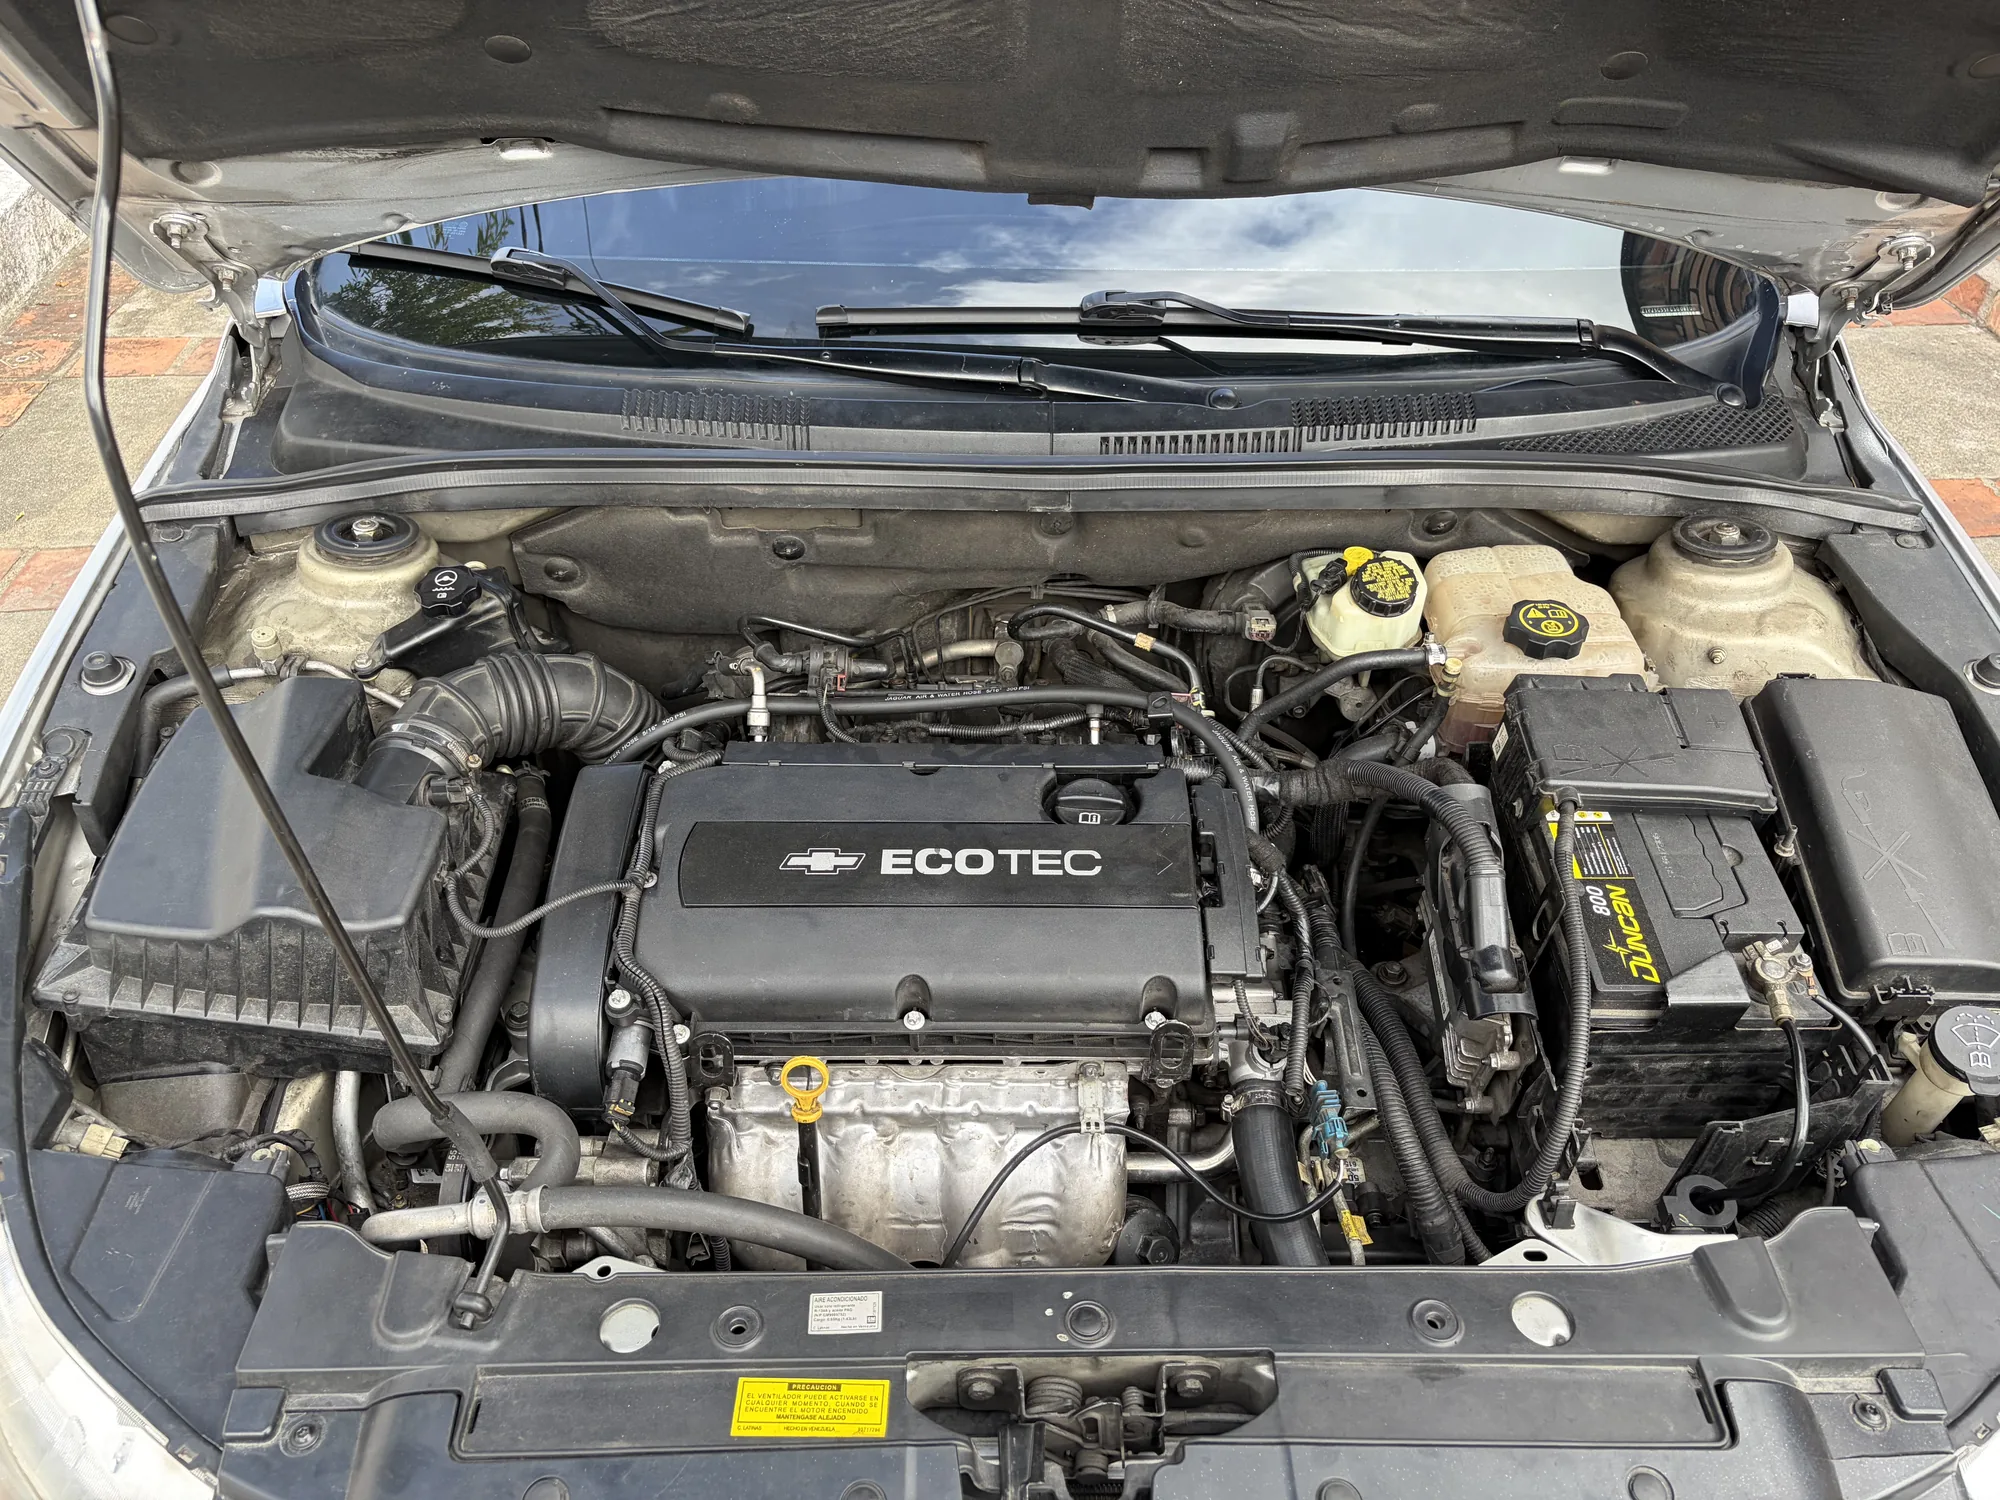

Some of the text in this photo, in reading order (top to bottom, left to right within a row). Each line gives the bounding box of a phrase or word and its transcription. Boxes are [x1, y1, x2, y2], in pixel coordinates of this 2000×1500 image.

[604, 749, 621, 765] ATER
[622, 736, 639, 750] HOSE
[661, 716, 674, 726] 300
[674, 711, 687, 720] PSI
[1212, 729, 1233, 752] JAGUAR
[1232, 754, 1241, 766] AIR
[1242, 775, 1253, 801] WATER
[1248, 804, 1257, 827] HOSE
[880, 847, 1102, 876] ECOTEC
[1585, 885, 1611, 916] 800
[792, 1383, 838, 1391] PRECAUCION
